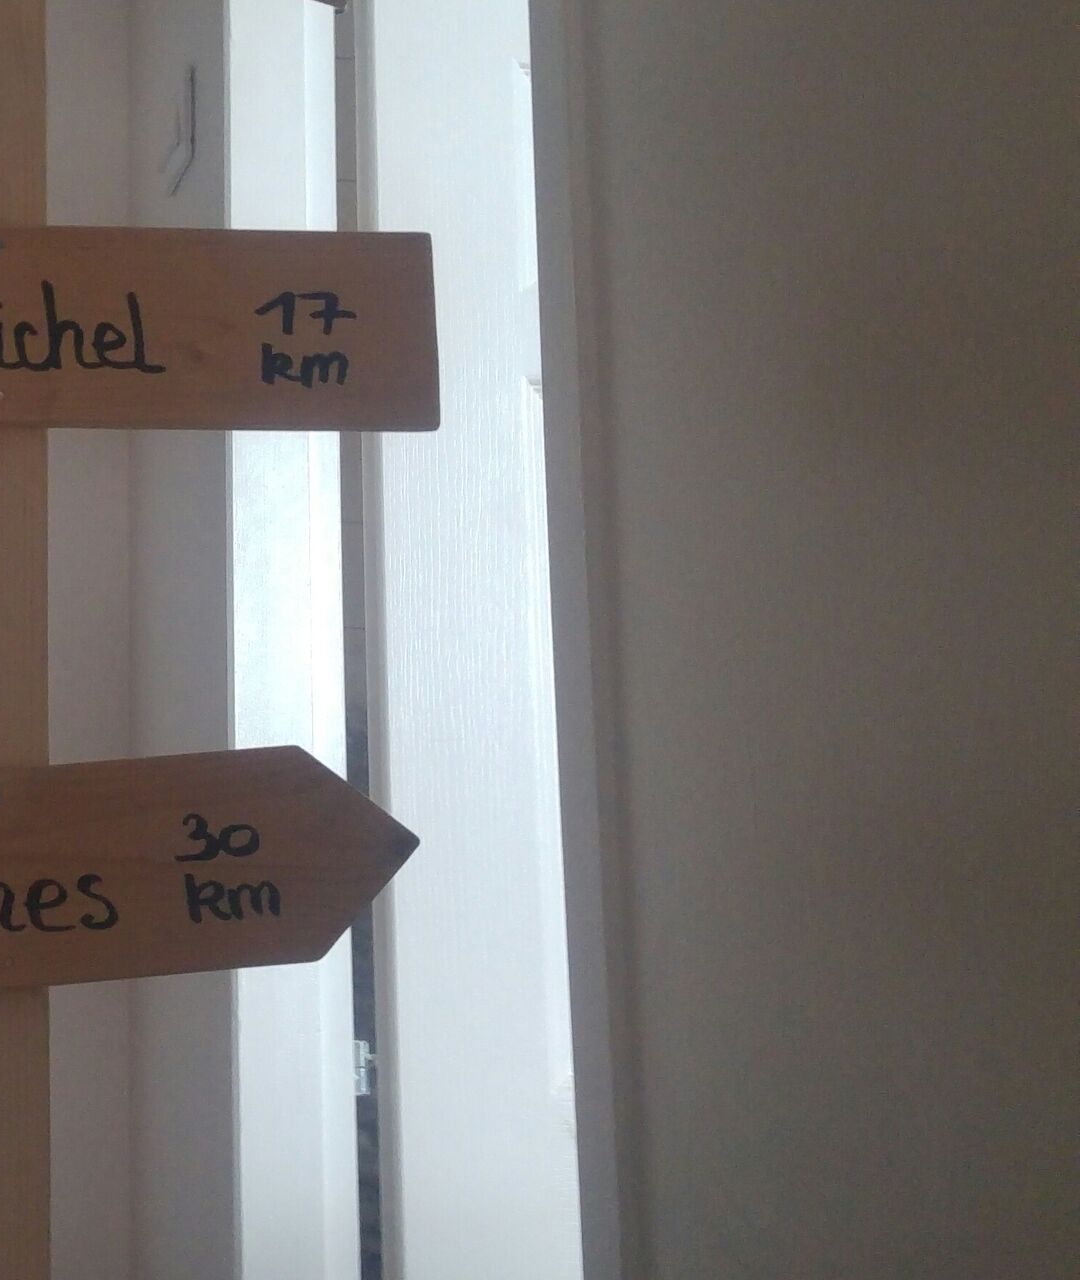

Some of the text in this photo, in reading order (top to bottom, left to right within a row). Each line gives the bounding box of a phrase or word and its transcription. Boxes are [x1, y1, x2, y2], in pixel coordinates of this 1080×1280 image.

[254, 290, 357, 336] 17
[260, 342, 348, 387] km
[174, 813, 260, 861] 30
[185, 873, 281, 922] km
